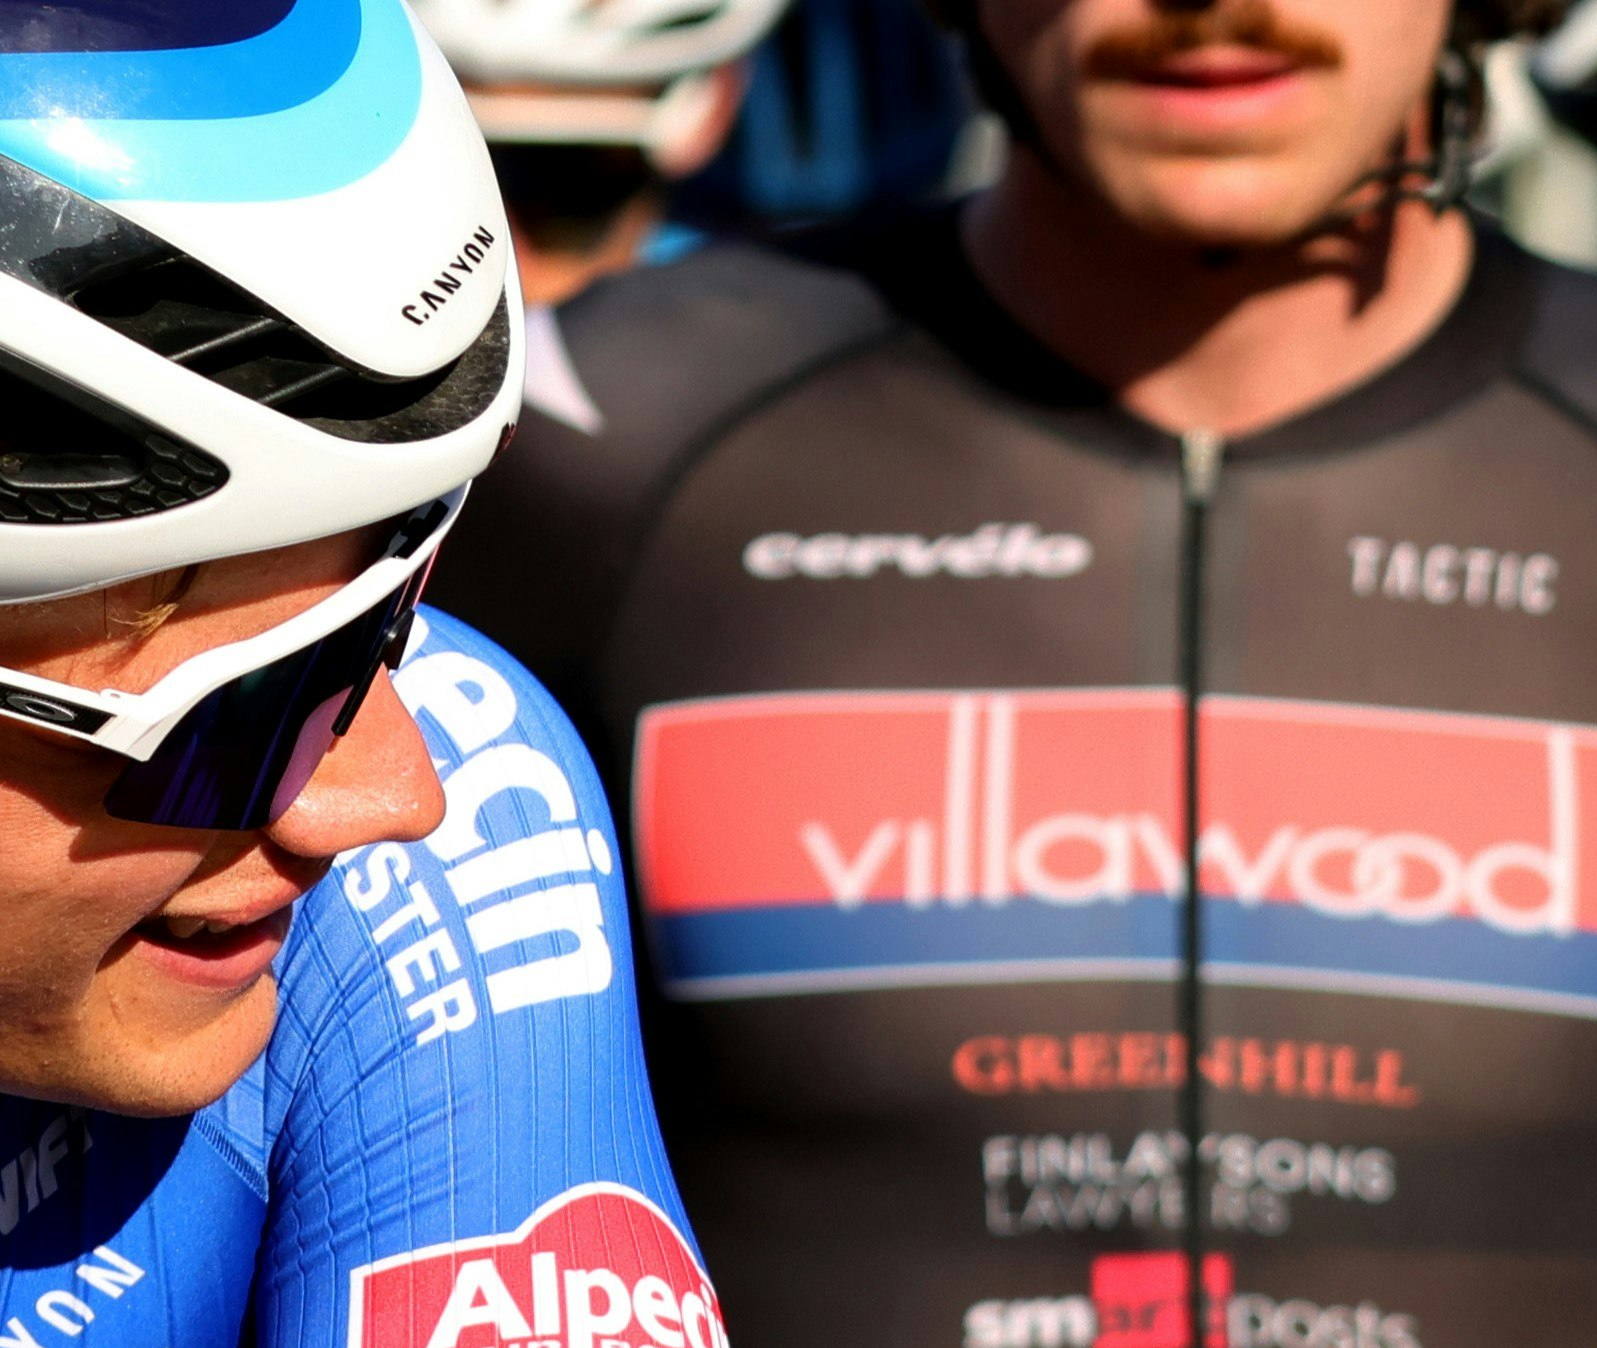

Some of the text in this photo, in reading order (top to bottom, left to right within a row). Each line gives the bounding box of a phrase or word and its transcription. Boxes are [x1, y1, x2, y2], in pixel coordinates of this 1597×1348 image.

[401, 226, 495, 327] CANYON
[1348, 536, 1560, 614] TACTIC
[800, 692, 1579, 938] villawood
[335, 842, 479, 1048] STER
